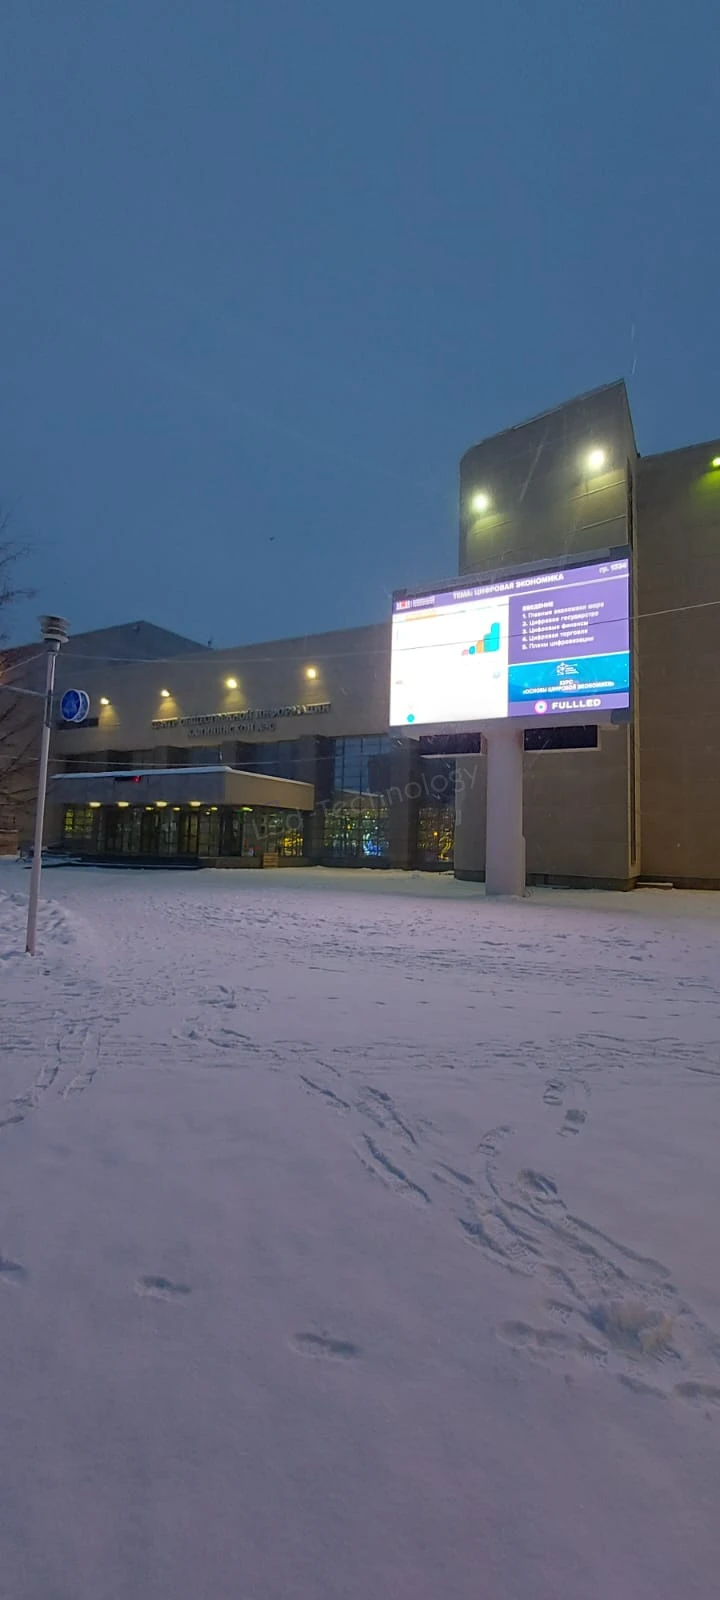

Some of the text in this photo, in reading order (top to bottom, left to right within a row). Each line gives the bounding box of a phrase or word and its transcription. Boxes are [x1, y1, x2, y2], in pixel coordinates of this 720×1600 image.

[474, 582, 513, 596] ЦИФРОВАЯ
[515, 573, 564, 588] ЭКОНОМИКА
[551, 698, 602, 710] FULLLED
